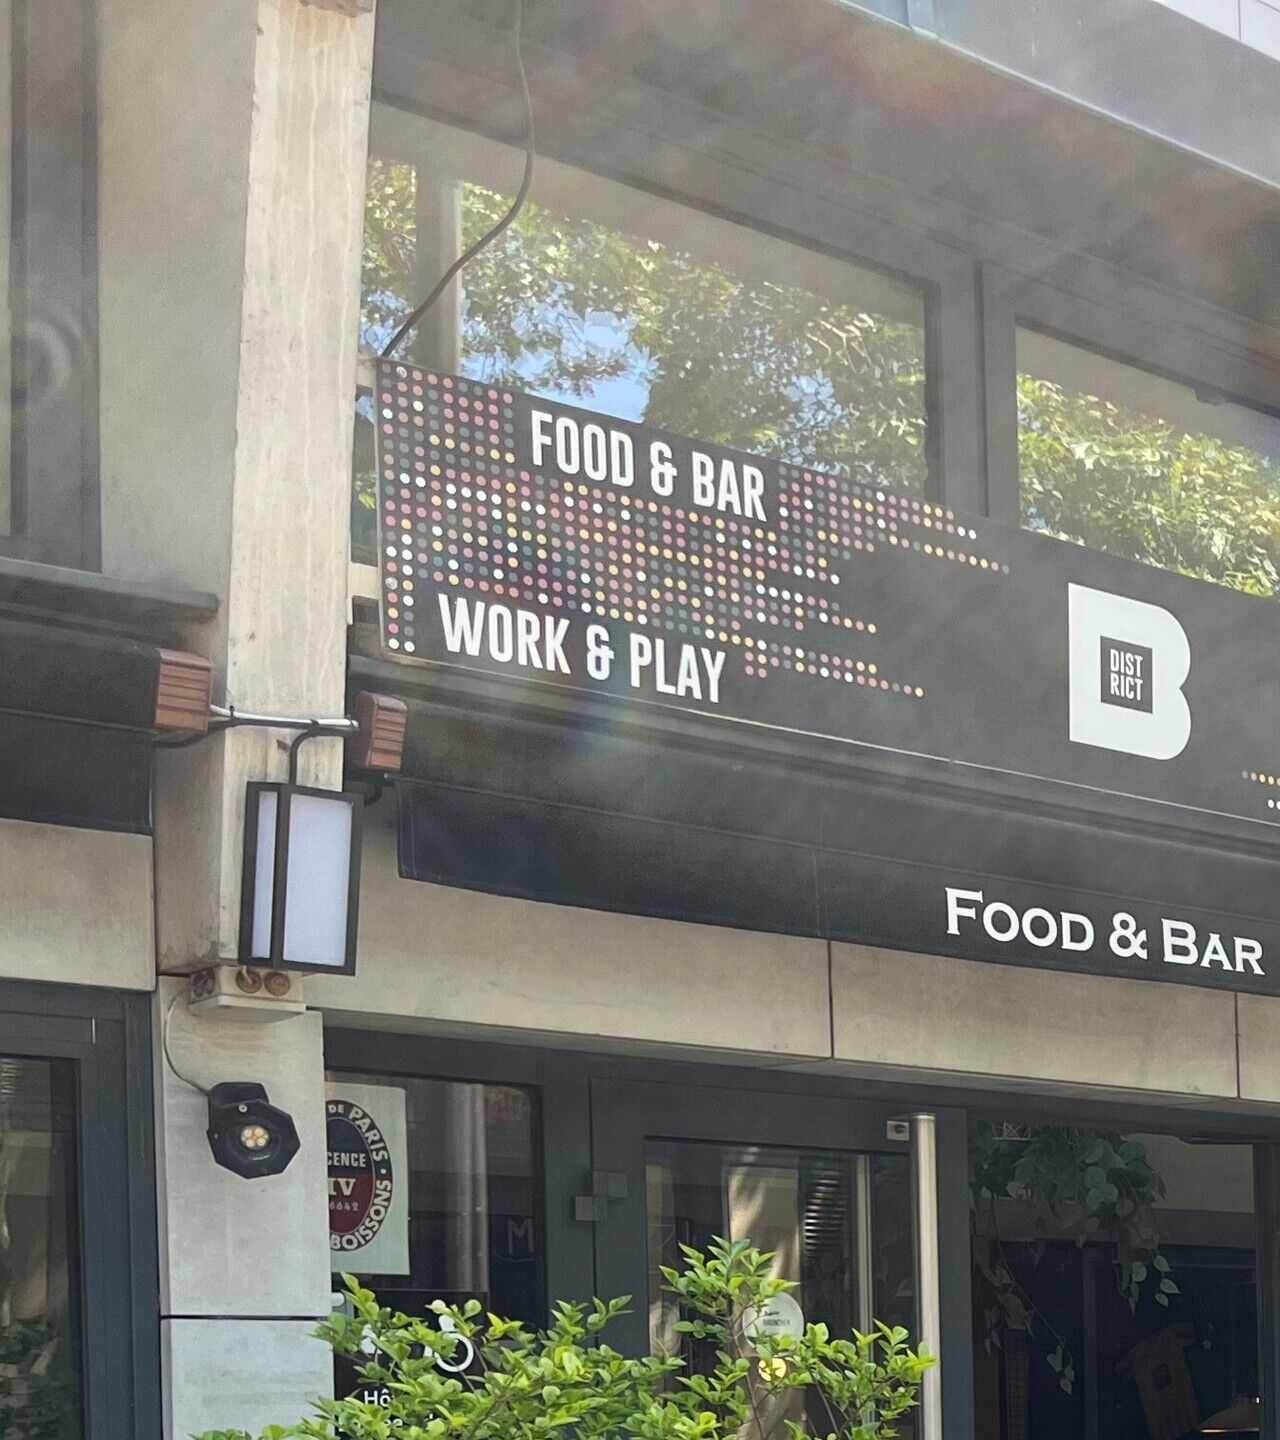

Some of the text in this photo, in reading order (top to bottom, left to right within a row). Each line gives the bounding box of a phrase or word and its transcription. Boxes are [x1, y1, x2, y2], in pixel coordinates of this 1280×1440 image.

[530, 410, 767, 521] FOOD & BAR
[438, 593, 727, 702] WORK & PLAY
[1068, 582, 1191, 760] B
[1109, 648, 1144, 677] DIST
[1109, 673, 1143, 701] RICT
[945, 887, 1265, 975] FOOD & BAR
[327, 1152, 366, 1167] CENCE
[349, 1106, 388, 1162] PARIS
[330, 1180, 392, 1250] BOISSONS
